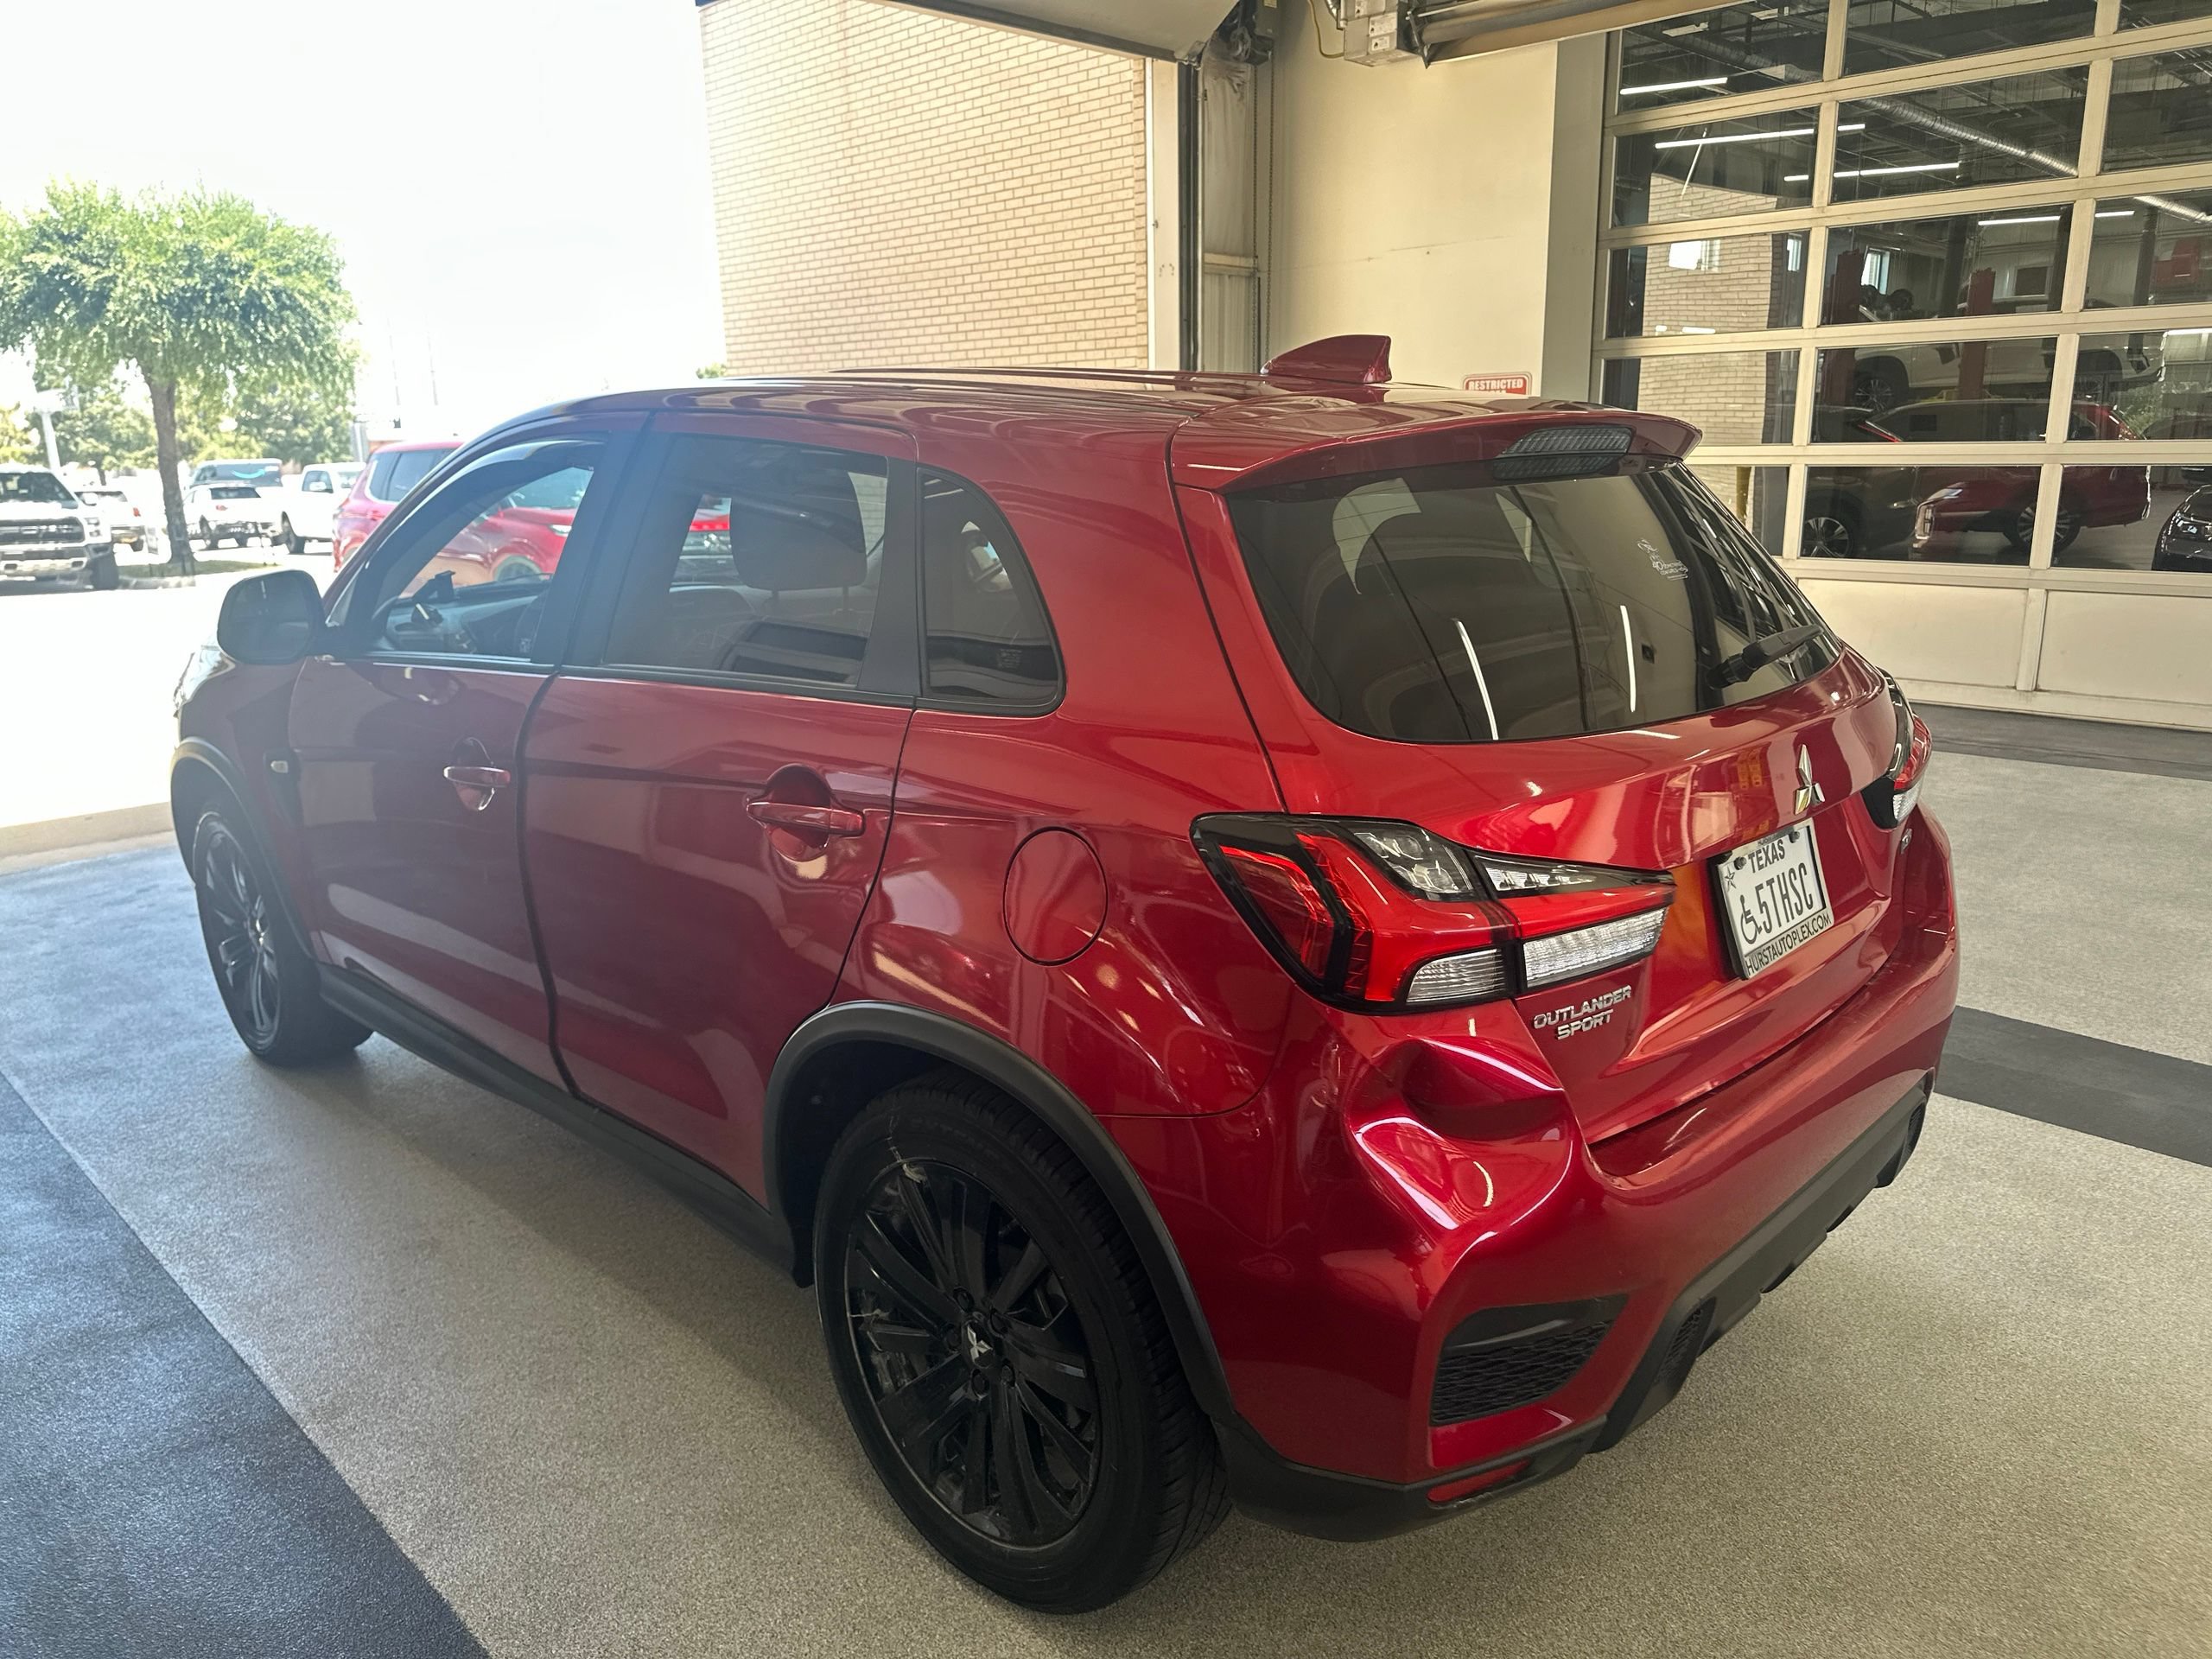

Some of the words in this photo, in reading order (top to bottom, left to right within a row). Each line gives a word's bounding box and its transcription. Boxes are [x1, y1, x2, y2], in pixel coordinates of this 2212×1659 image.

[1469, 378, 1523, 391] RESTRICTED
[1748, 839, 1785, 874] TEXAS
[1754, 862, 1814, 934] 5THSC
[1745, 912, 1832, 976] HURSTAUTOPLEX.COM
[1534, 984, 1632, 1029] OUTLANDER
[1557, 1008, 1614, 1040] SPORT
